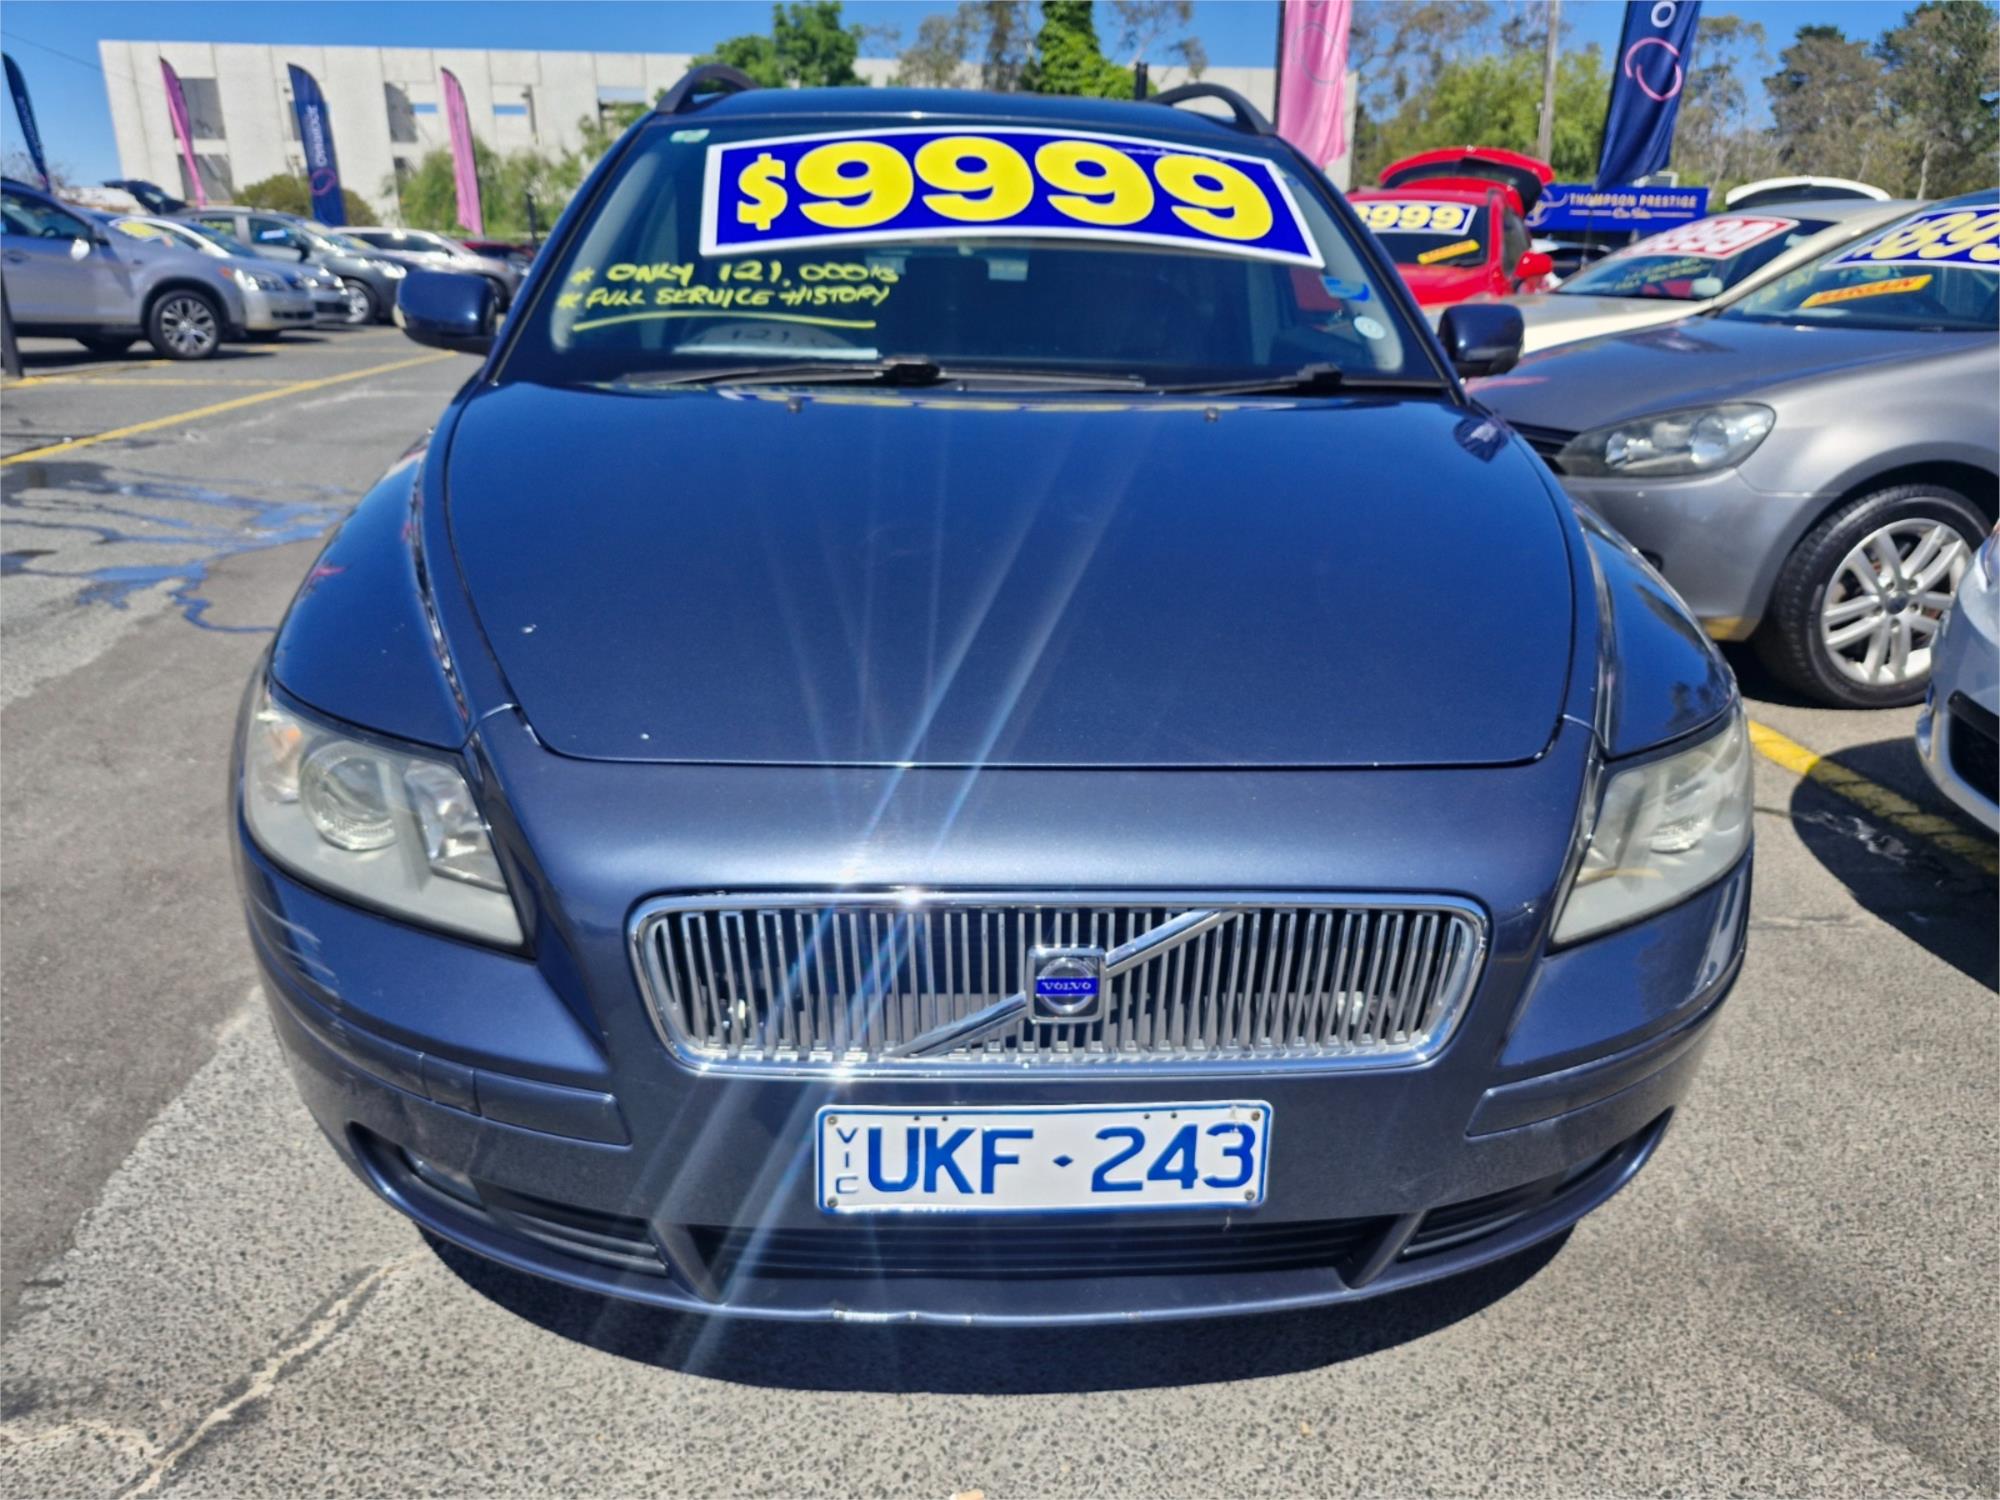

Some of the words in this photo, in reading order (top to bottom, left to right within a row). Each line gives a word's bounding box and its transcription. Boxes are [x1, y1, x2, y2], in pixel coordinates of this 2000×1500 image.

[737, 136, 1273, 240] $9999
[1570, 193, 1637, 207] THOMPSON
[1640, 194, 1697, 208] PRESTIGE
[607, 262, 694, 286] ONLY
[586, 288, 646, 307] FULL
[656, 286, 774, 308] SERVICE
[780, 285, 889, 306] HISTORY
[1041, 981, 1092, 991] VOLVO
[835, 1127, 859, 1195] VIC
[867, 1126, 1034, 1194] UKF
[1091, 1122, 1257, 1193] 243
